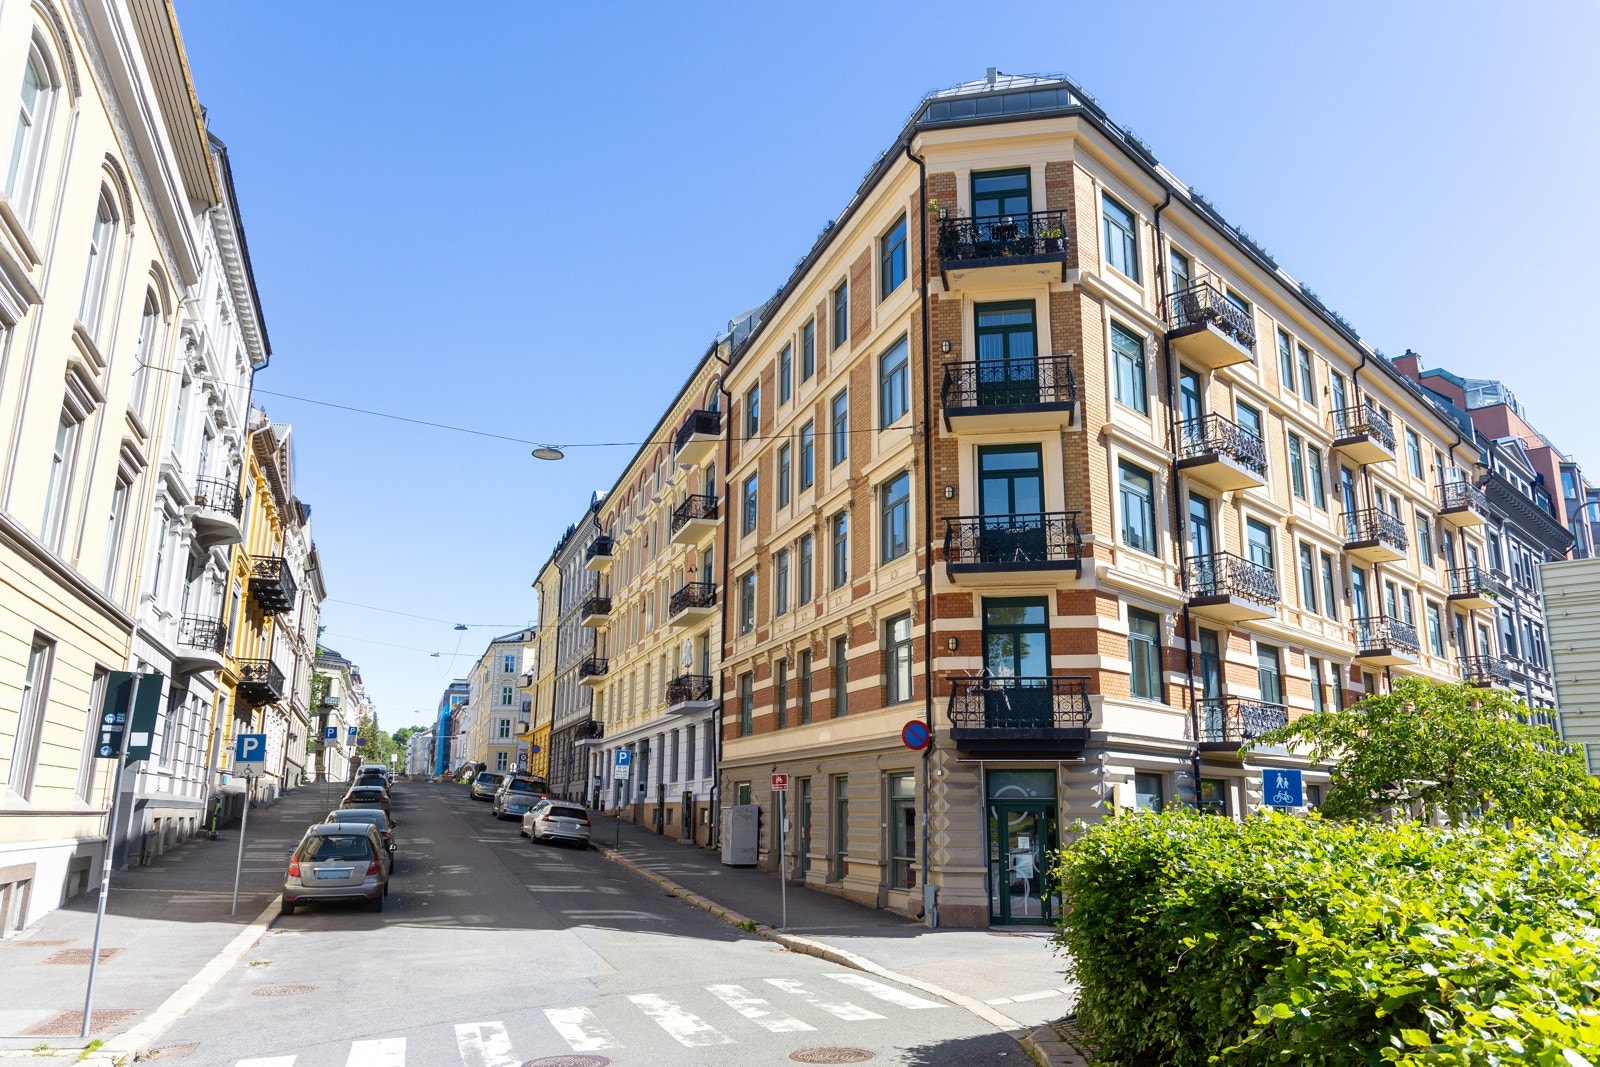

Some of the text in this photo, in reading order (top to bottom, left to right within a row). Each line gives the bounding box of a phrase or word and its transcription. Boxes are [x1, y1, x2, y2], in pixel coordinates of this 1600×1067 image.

[328, 728, 335, 737] P
[242, 737, 259, 759] P
[619, 752, 627, 763] P
